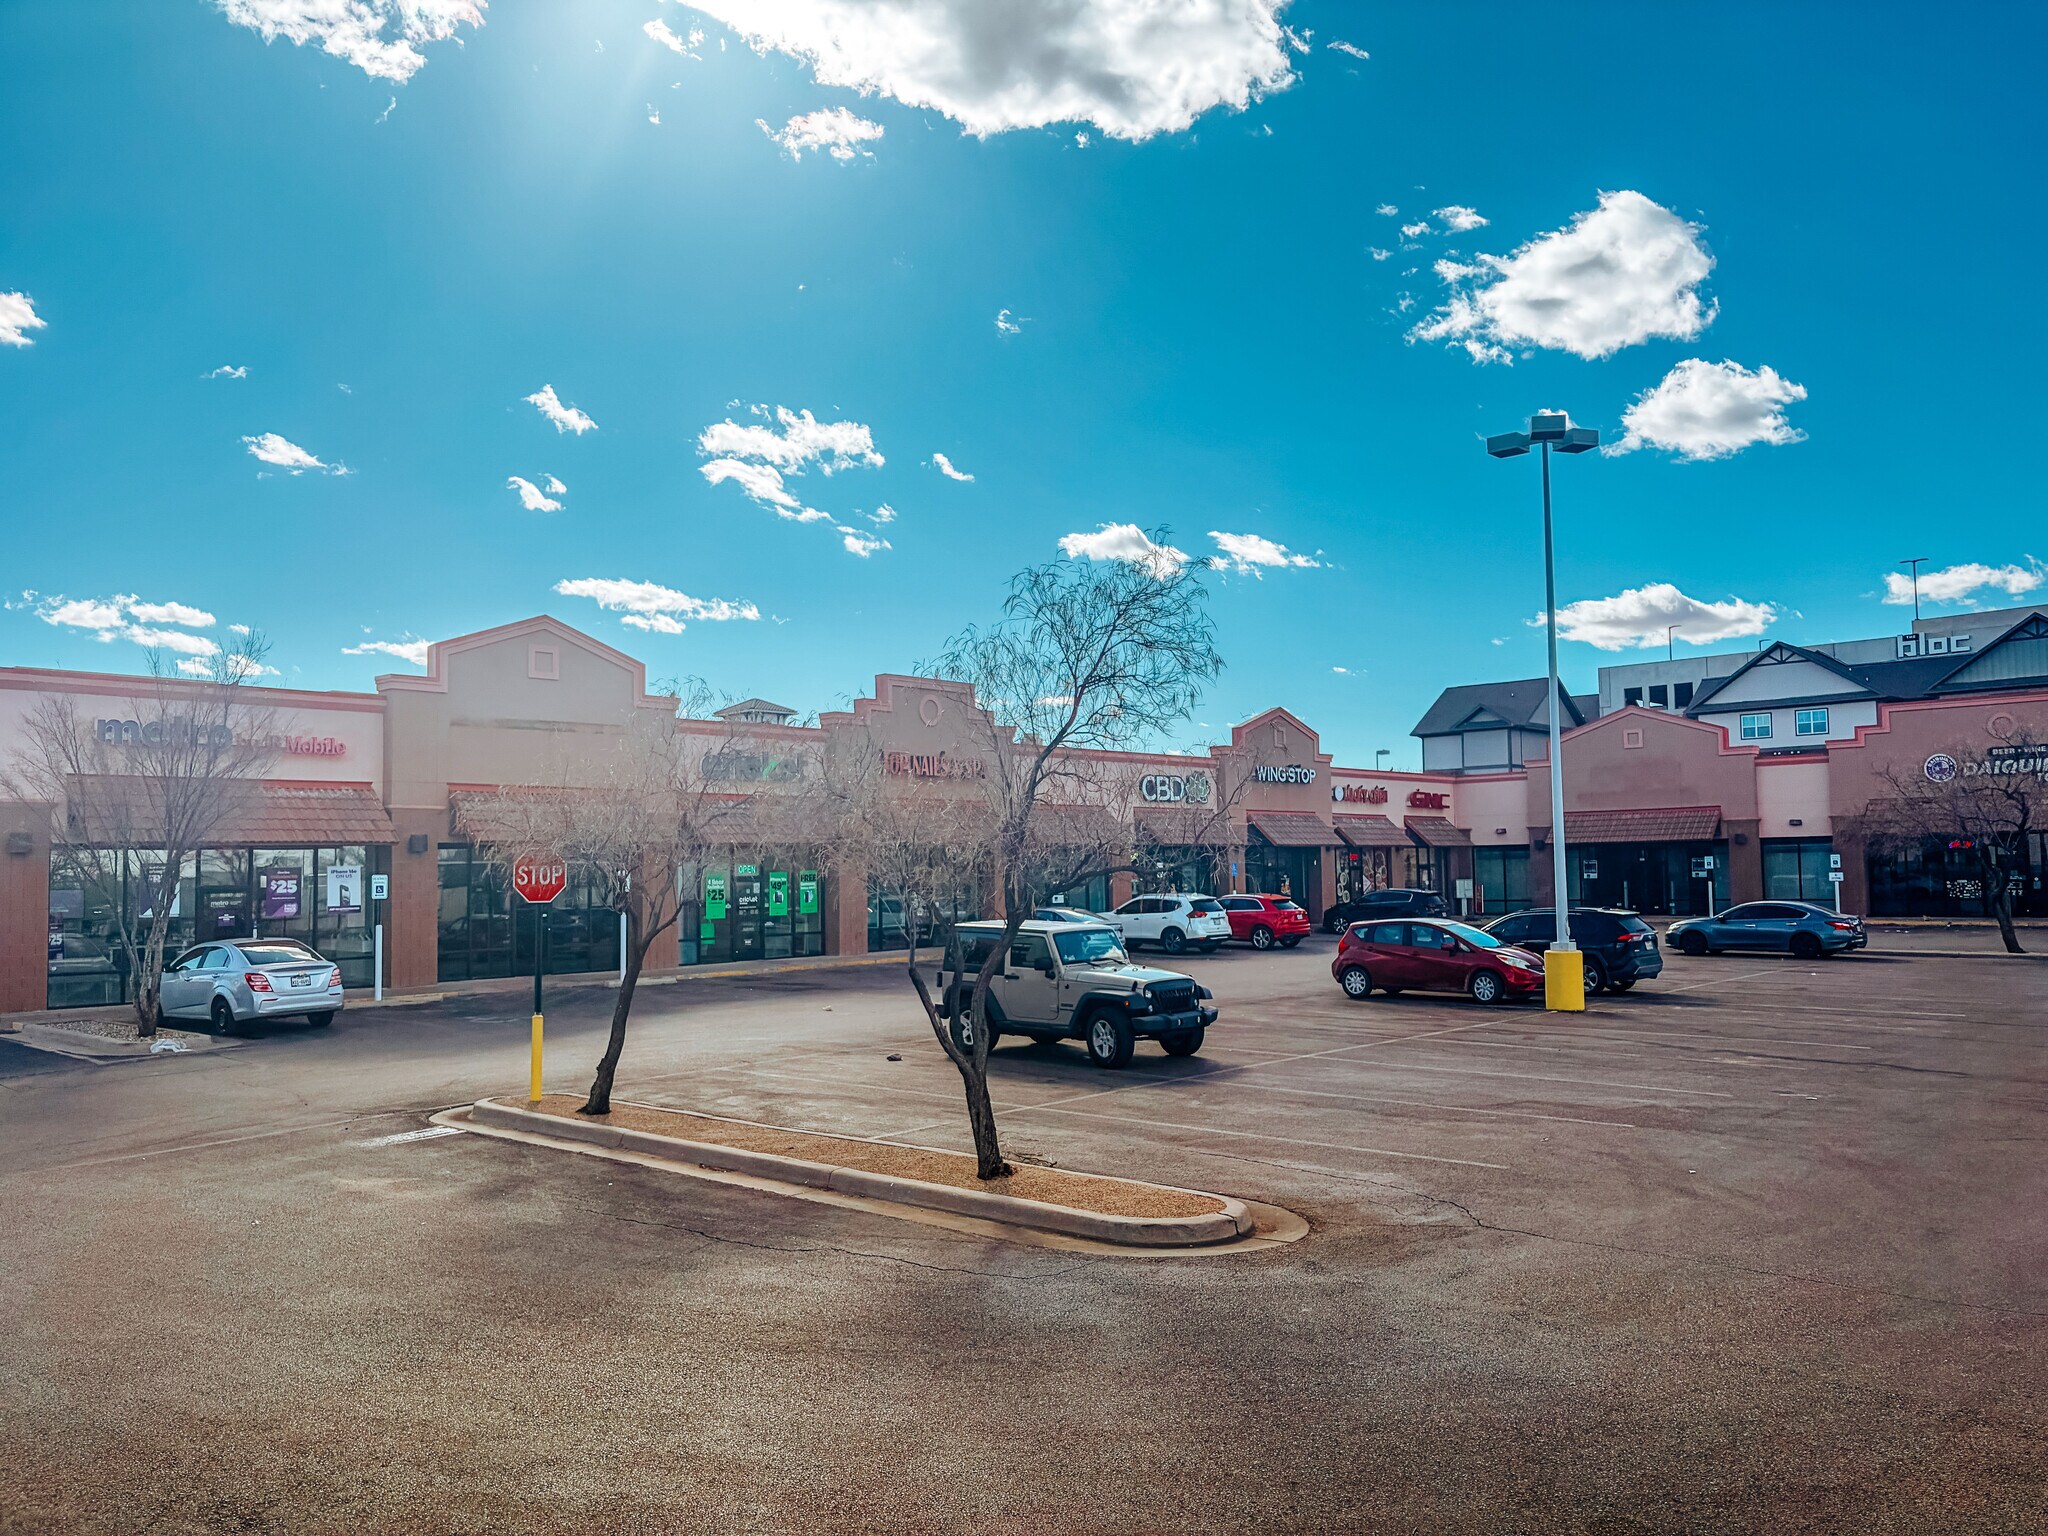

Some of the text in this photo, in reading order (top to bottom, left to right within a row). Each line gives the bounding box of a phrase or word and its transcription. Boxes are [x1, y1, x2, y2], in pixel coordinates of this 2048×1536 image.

[1897, 632, 1971, 658] bloc
[1141, 775, 1185, 801] CBD
[1408, 792, 1450, 809] GNC
[517, 865, 563, 886] STOP
[738, 865, 756, 874] OPEN
[801, 874, 816, 882] FREE
[270, 879, 298, 894] $25
[707, 889, 725, 900] $25
